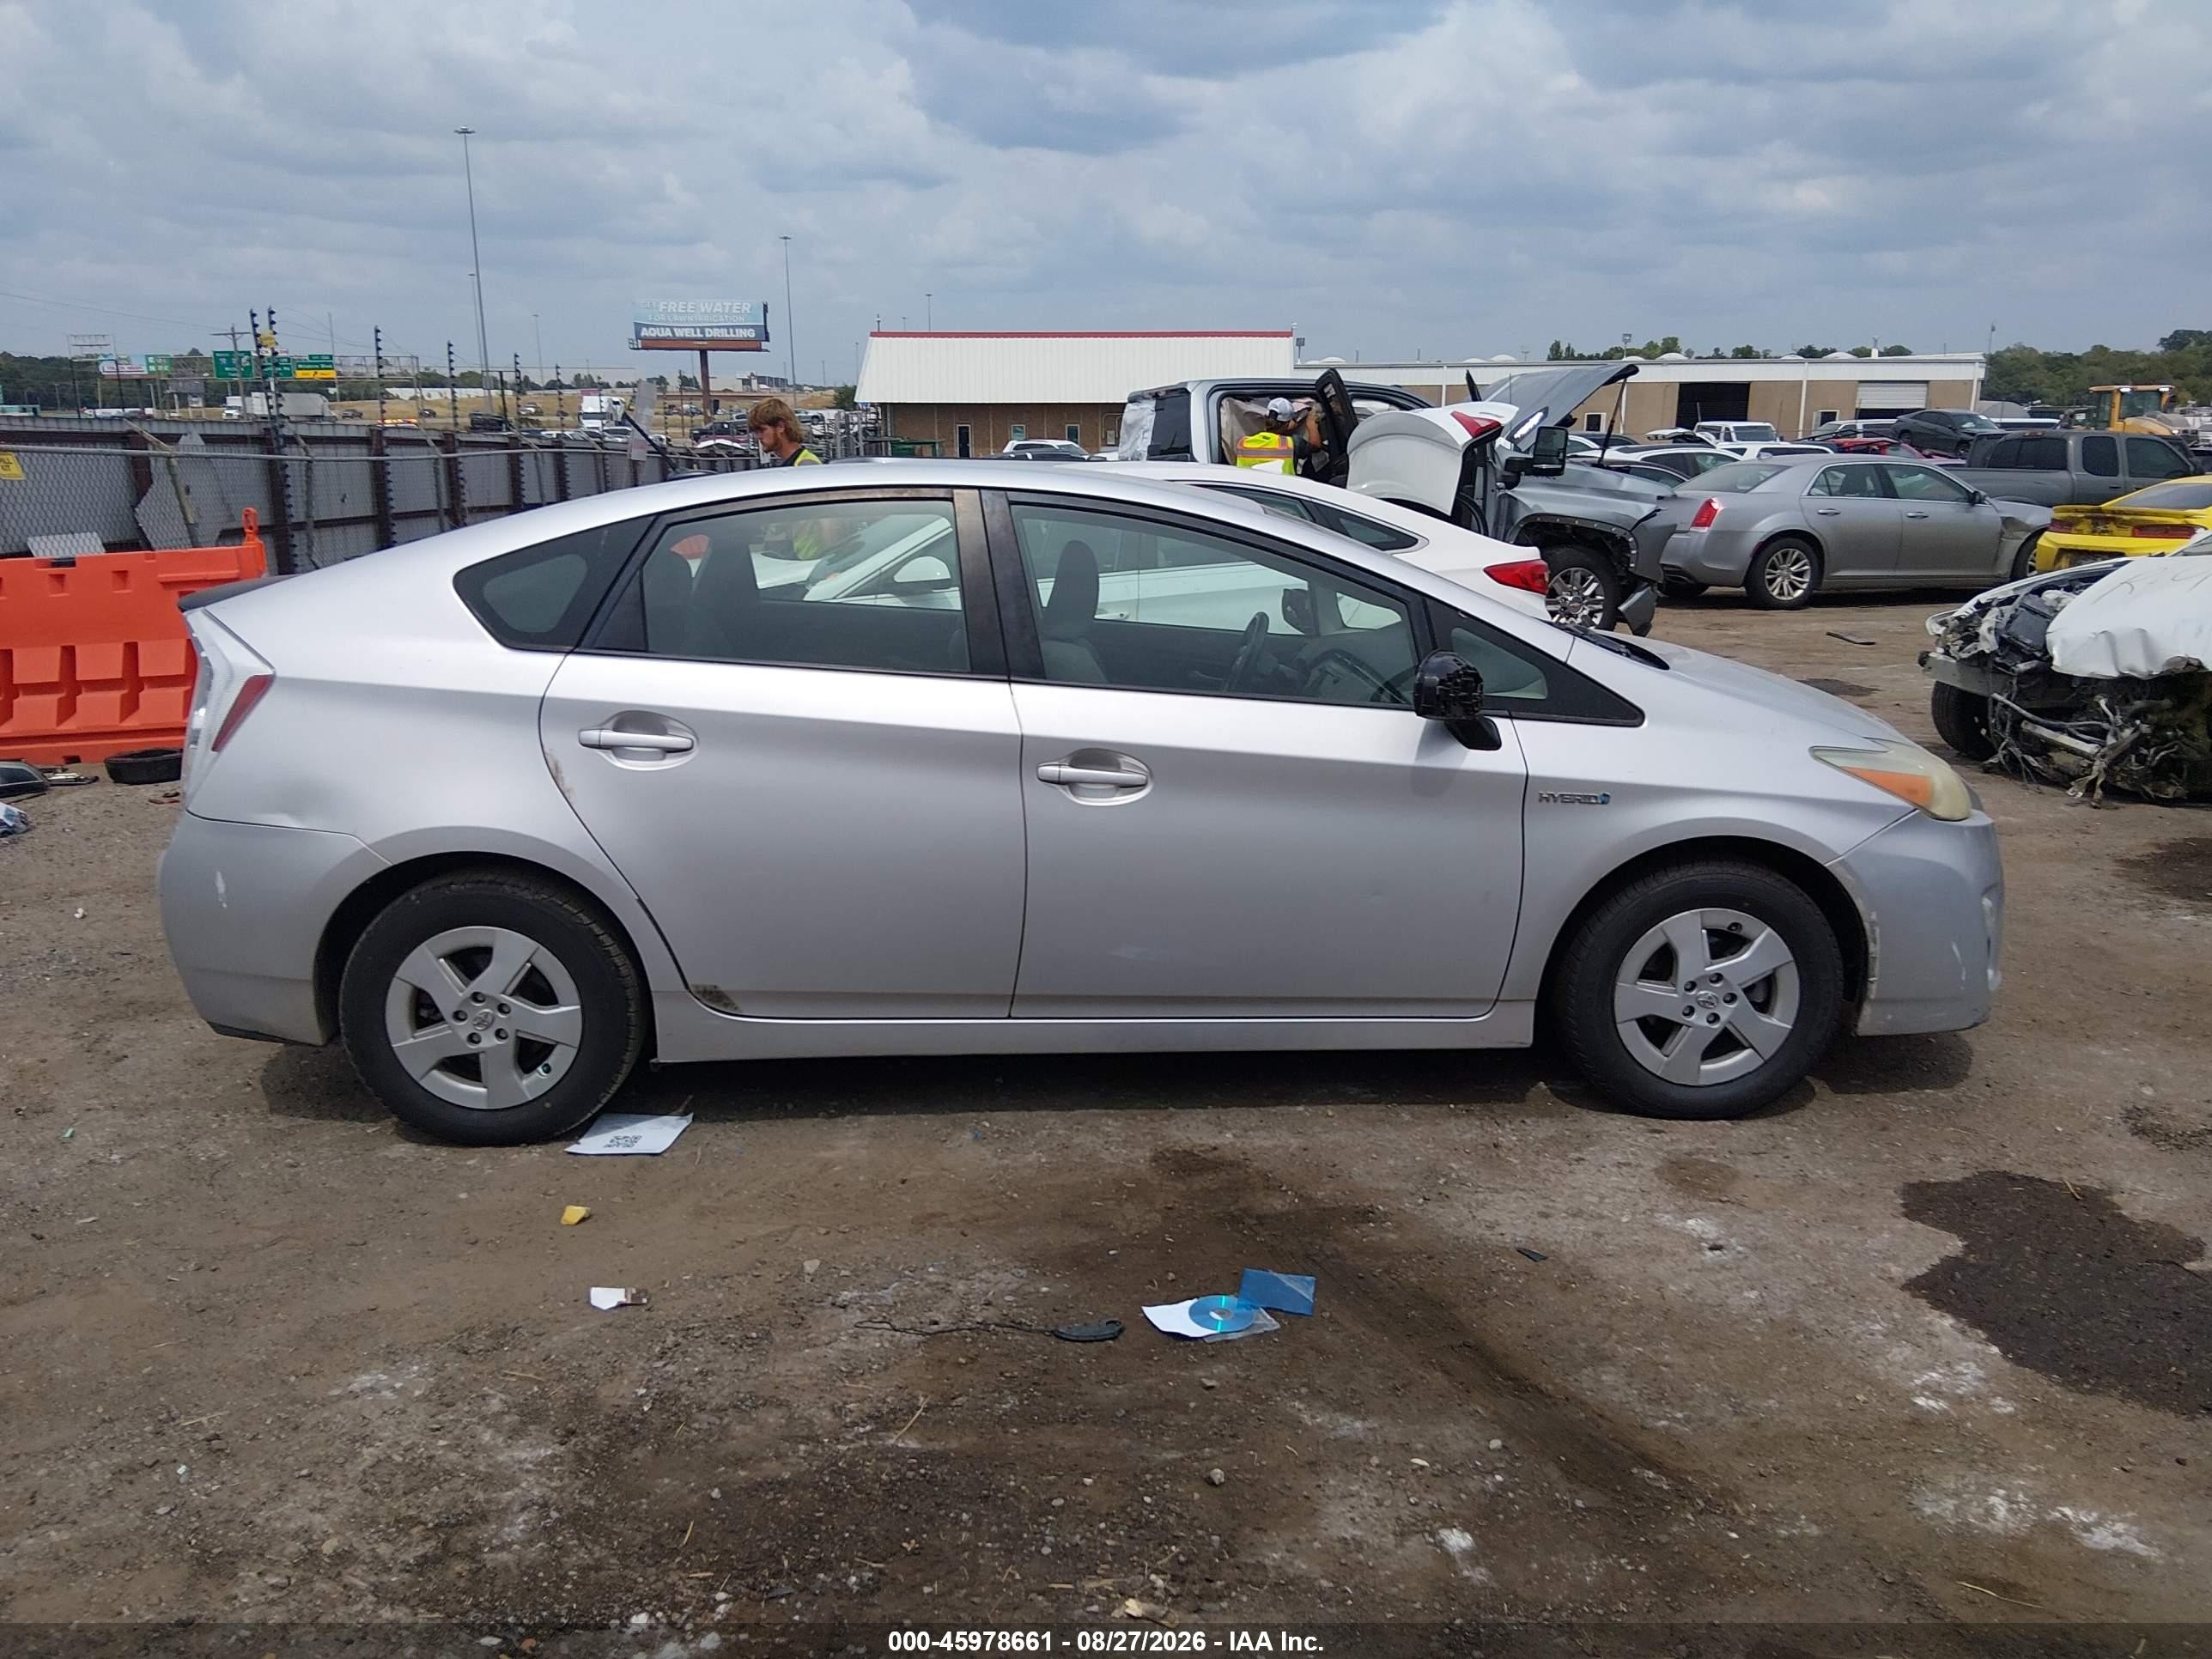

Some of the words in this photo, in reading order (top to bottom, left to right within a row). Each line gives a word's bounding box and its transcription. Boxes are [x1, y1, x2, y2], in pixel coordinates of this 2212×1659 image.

[659, 301, 696, 313] FREE
[697, 301, 751, 314] WATER
[641, 326, 673, 337] AQUA
[673, 327, 704, 338] WELL
[705, 327, 756, 338] DRILLING
[1538, 791, 1600, 805] HYBRID
